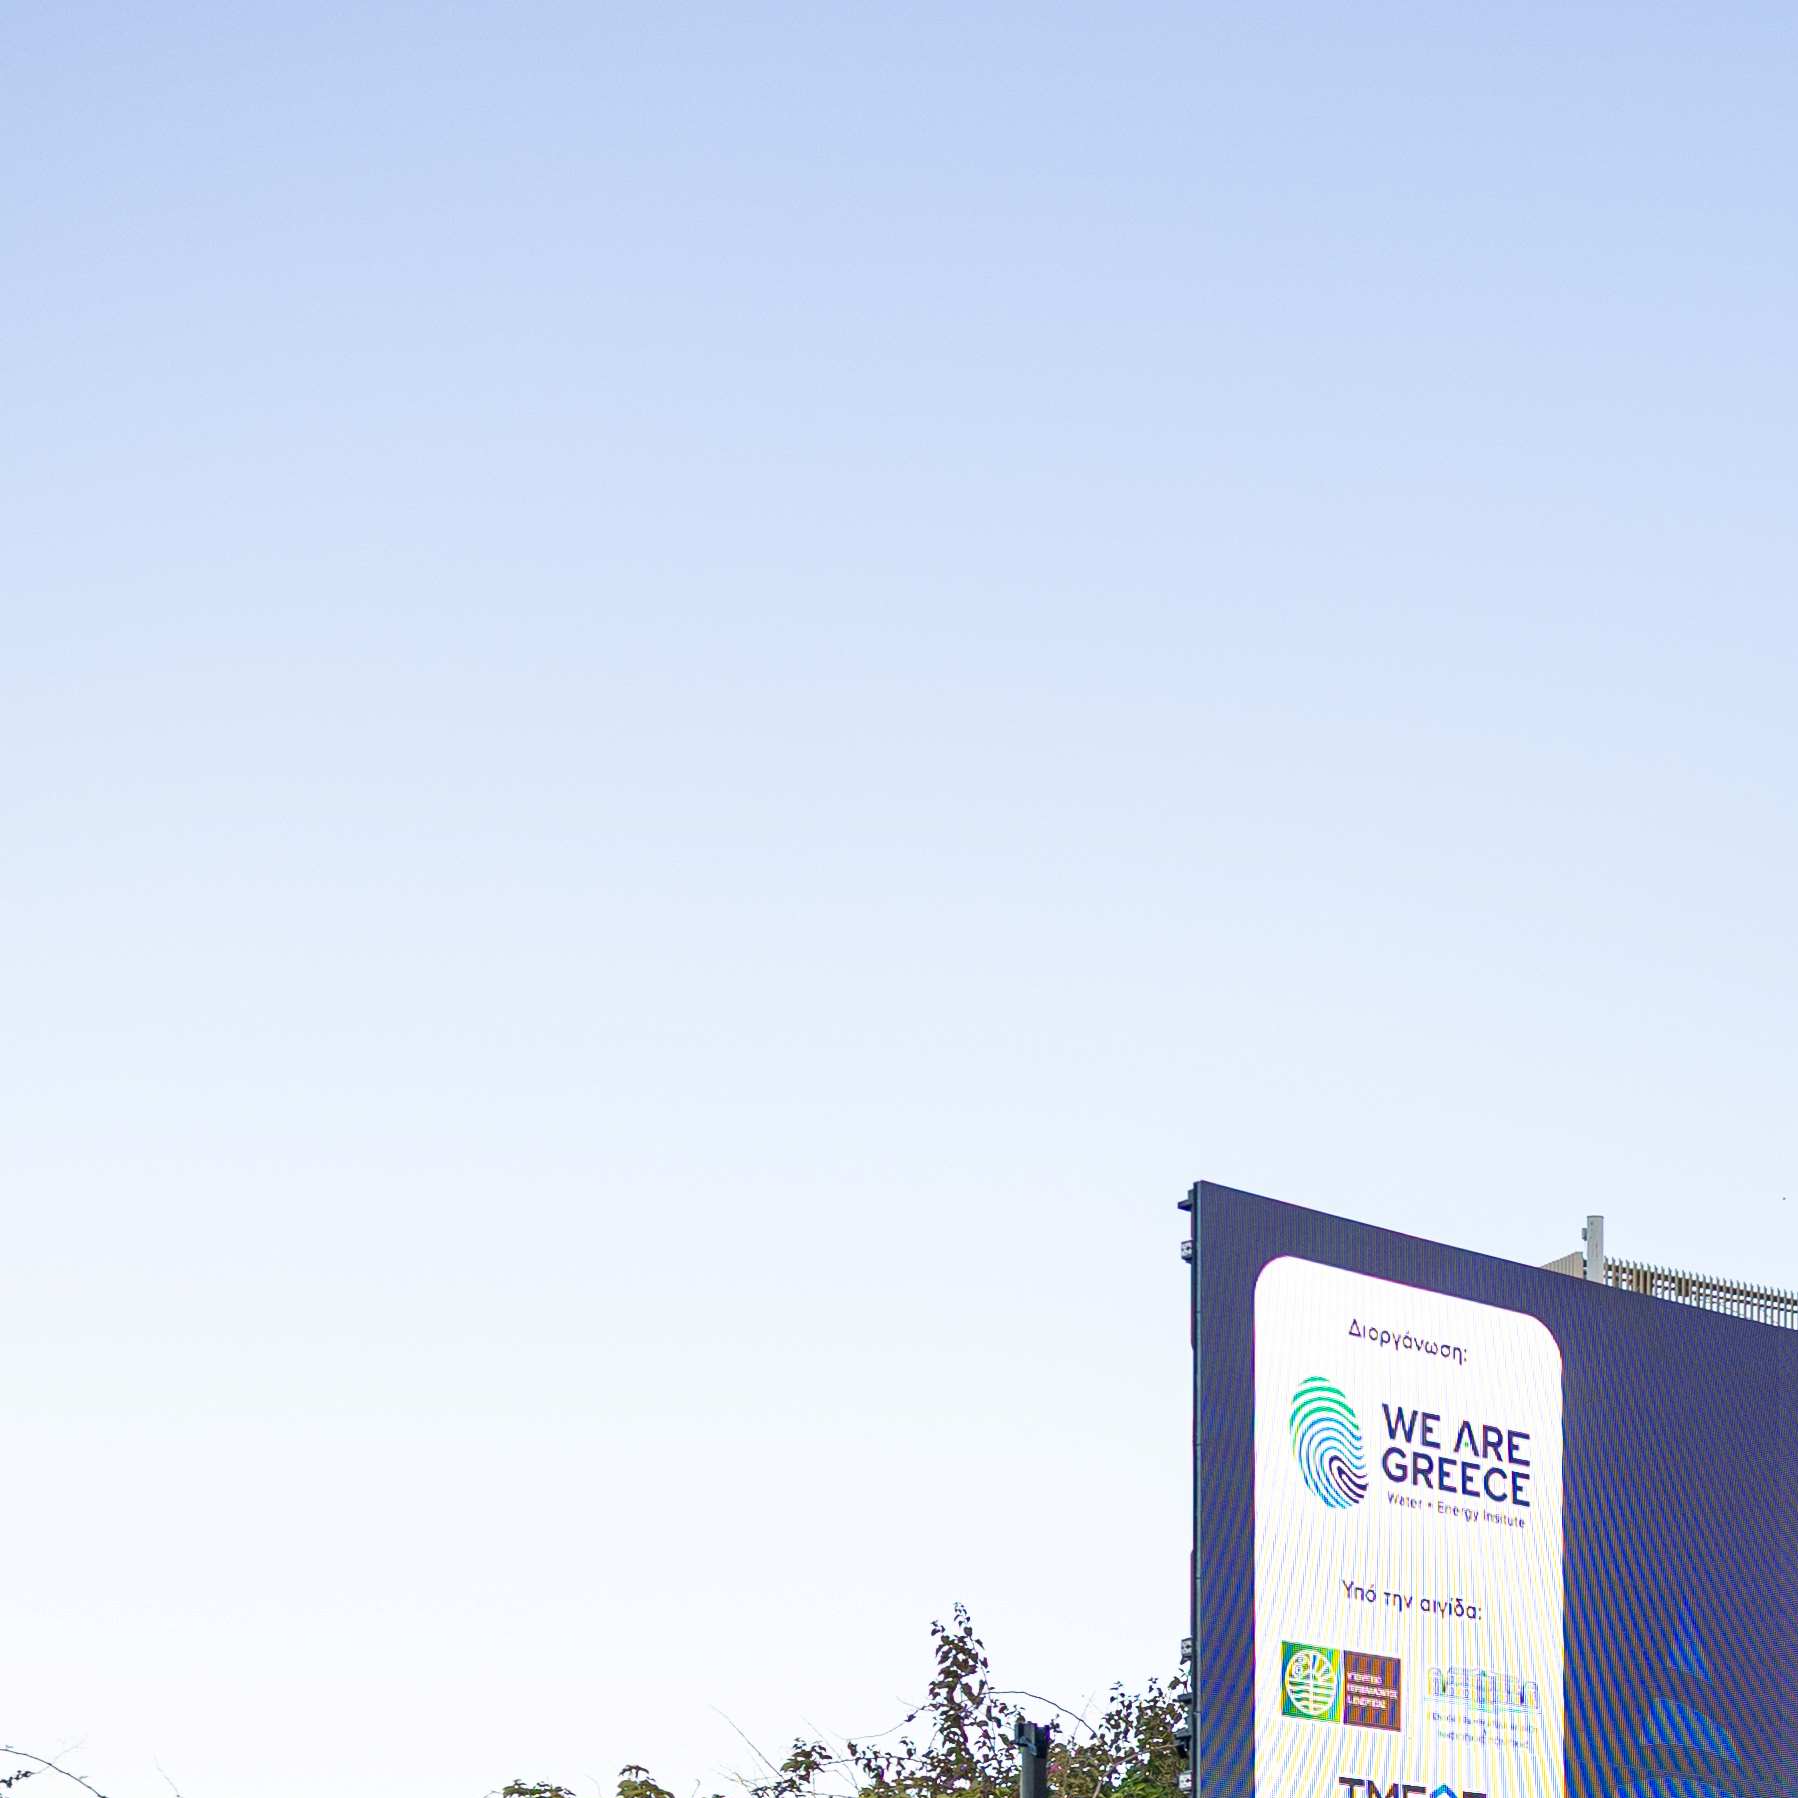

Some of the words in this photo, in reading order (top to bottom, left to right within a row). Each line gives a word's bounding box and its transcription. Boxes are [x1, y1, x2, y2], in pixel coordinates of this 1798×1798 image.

[1348, 1318, 1468, 1363] Διοργάνωση:
[1381, 1402, 1441, 1449] WE
[1454, 1420, 1531, 1467] ARE
[1381, 1446, 1531, 1508] GREECE
[1341, 1578, 1377, 1605] Υπό
[1382, 1591, 1413, 1614] την
[1419, 1596, 1483, 1622] αιγίδα:
